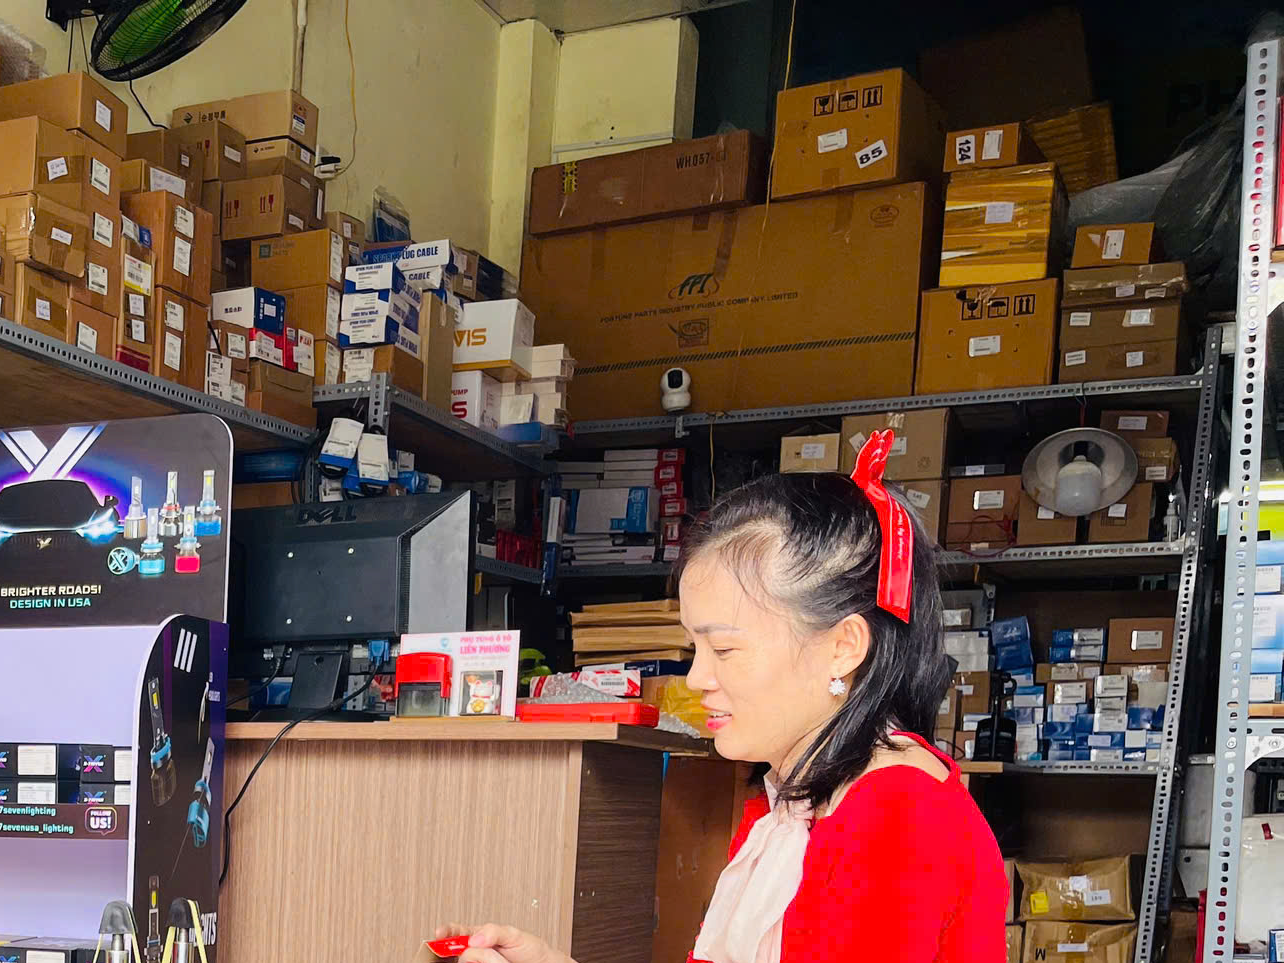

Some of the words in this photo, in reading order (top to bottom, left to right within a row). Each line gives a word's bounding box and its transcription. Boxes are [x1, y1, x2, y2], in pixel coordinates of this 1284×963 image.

[859, 146, 883, 165] 85
[957, 138, 972, 162] 124
[417, 246, 439, 258] CABLE
[408, 271, 430, 281] CABLE
[0, 585, 56, 597] BRIGHTER
[58, 584, 102, 596] ROADS!
[9, 599, 52, 609] DESIGN
[54, 599, 66, 608] IN
[67, 597, 91, 608] USA
[90, 817, 112, 829] US!
